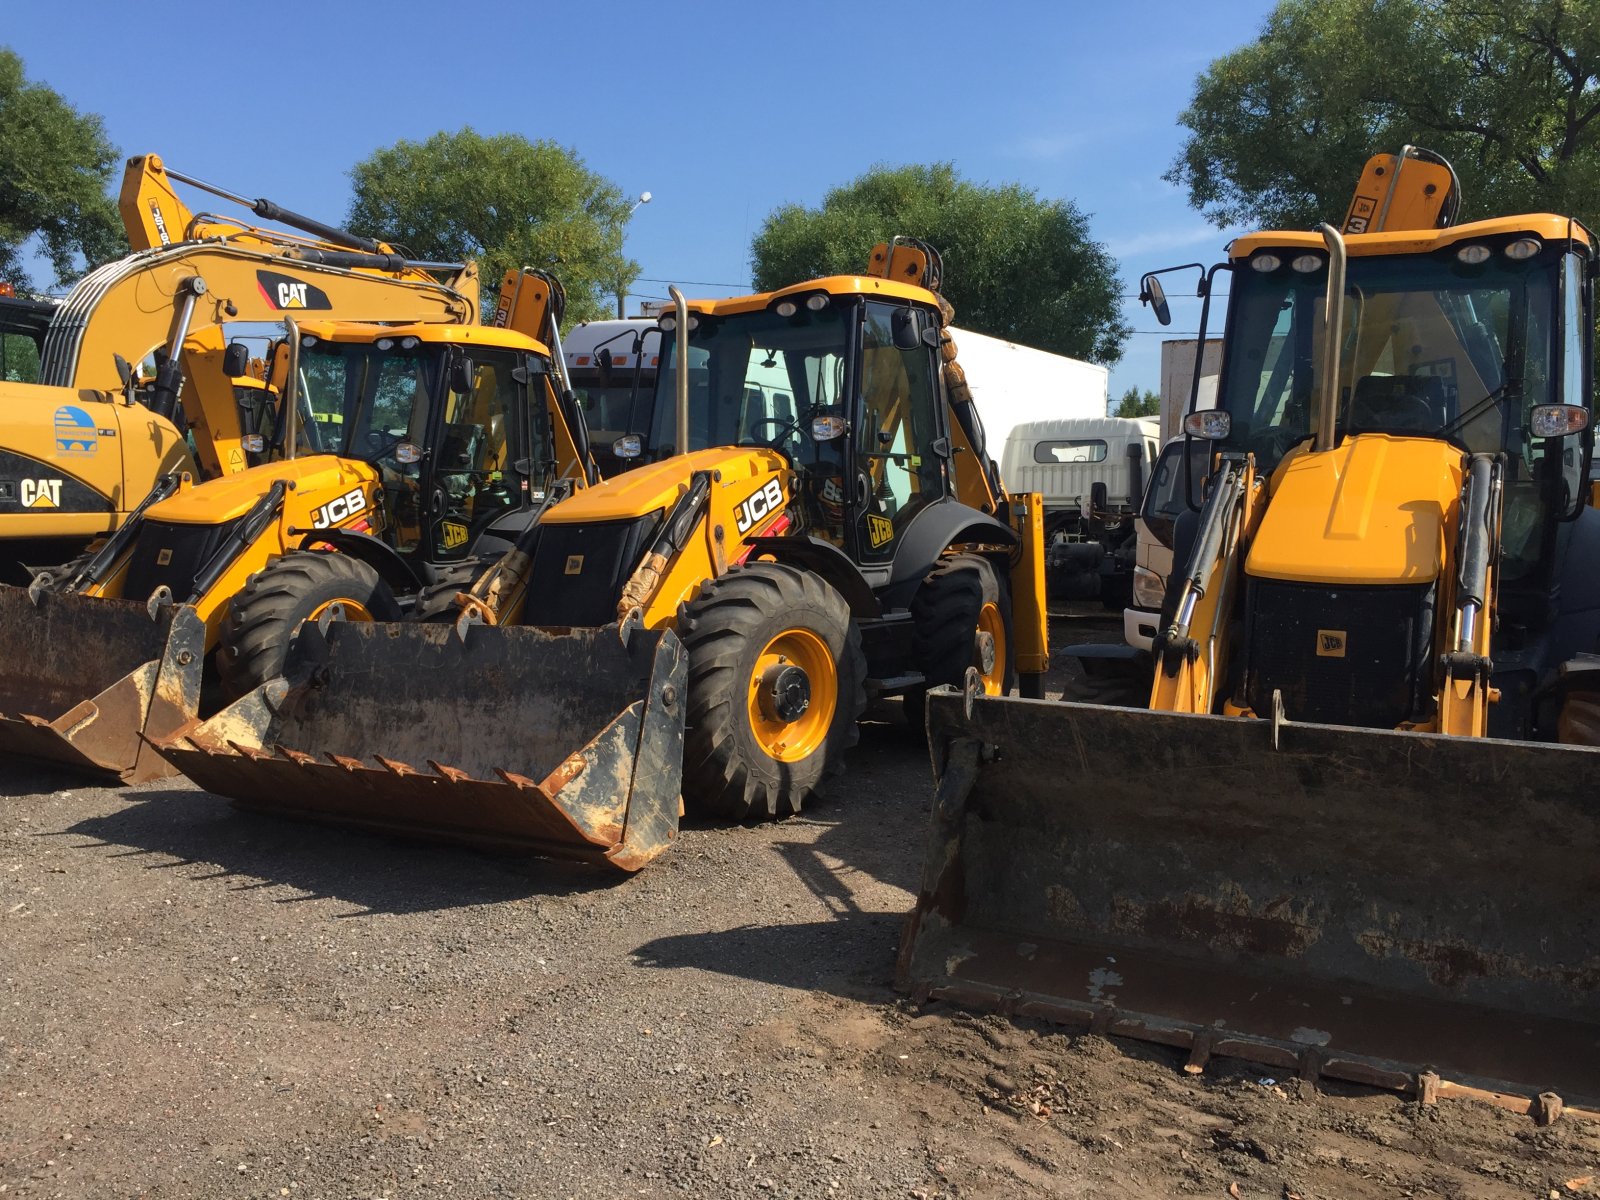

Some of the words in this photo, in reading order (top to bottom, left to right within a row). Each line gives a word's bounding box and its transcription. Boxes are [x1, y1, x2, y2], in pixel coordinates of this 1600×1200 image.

[277, 283, 307, 307] CAT
[21, 479, 62, 507] CAT
[738, 479, 783, 532] JCB
[314, 489, 365, 529] JCB
[446, 525, 467, 546] JCB
[871, 518, 892, 544] JCB
